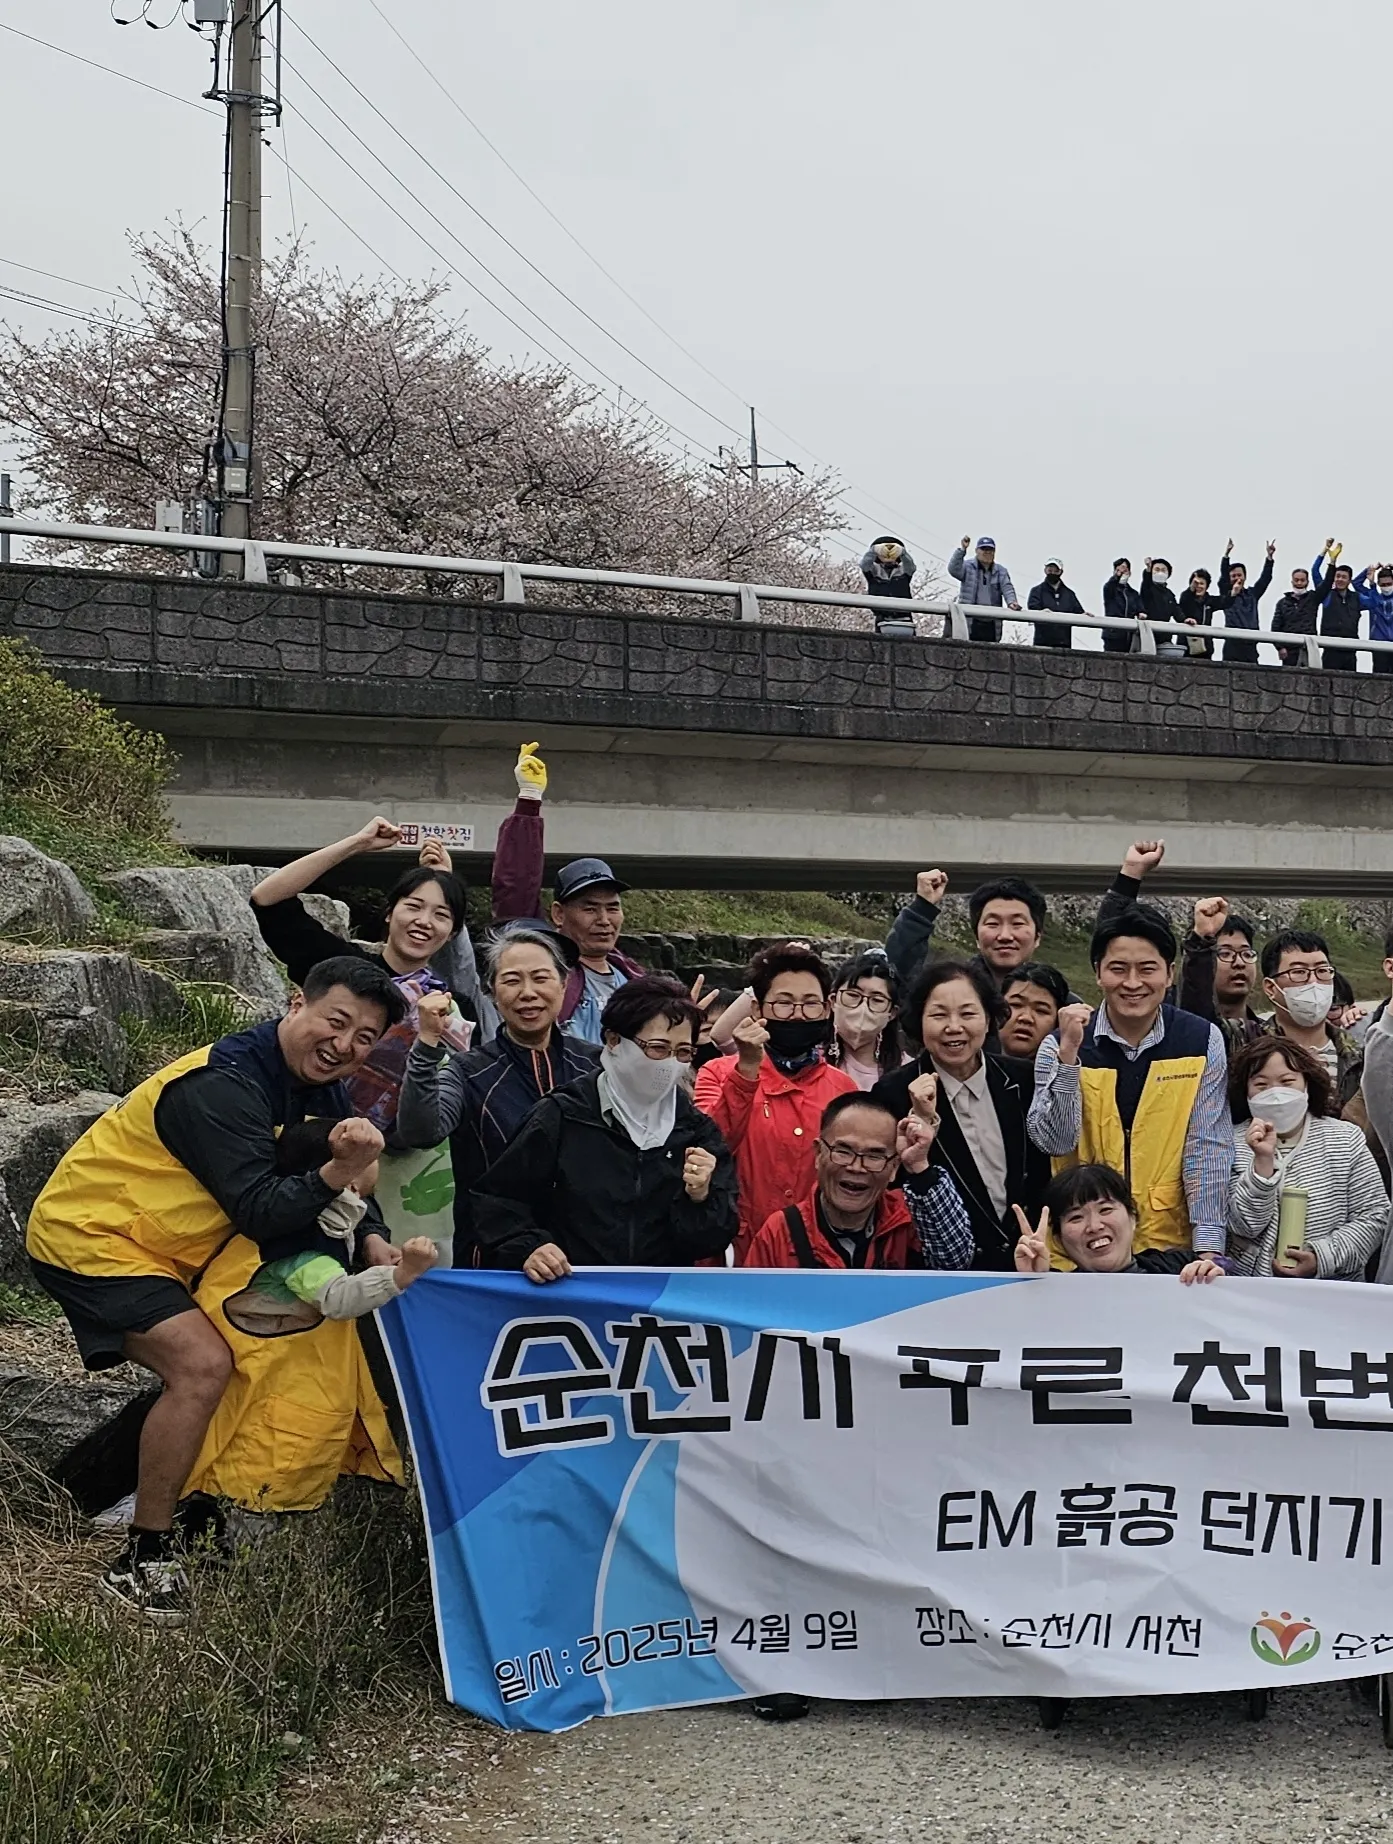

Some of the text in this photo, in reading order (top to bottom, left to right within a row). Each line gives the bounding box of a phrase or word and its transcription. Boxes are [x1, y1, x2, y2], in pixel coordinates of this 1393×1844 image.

[485, 1313, 854, 1452] 순천시
[897, 1345, 1133, 1427] 푸른
[936, 1490, 1037, 1552] EM
[1055, 1482, 1177, 1549] 흙공
[1200, 1489, 1383, 1569] 던지기
[577, 1616, 717, 1675] 2025년
[731, 1614, 790, 1654] 4월
[803, 1610, 858, 1651] 9일
[1000, 1613, 1112, 1649] 순천시
